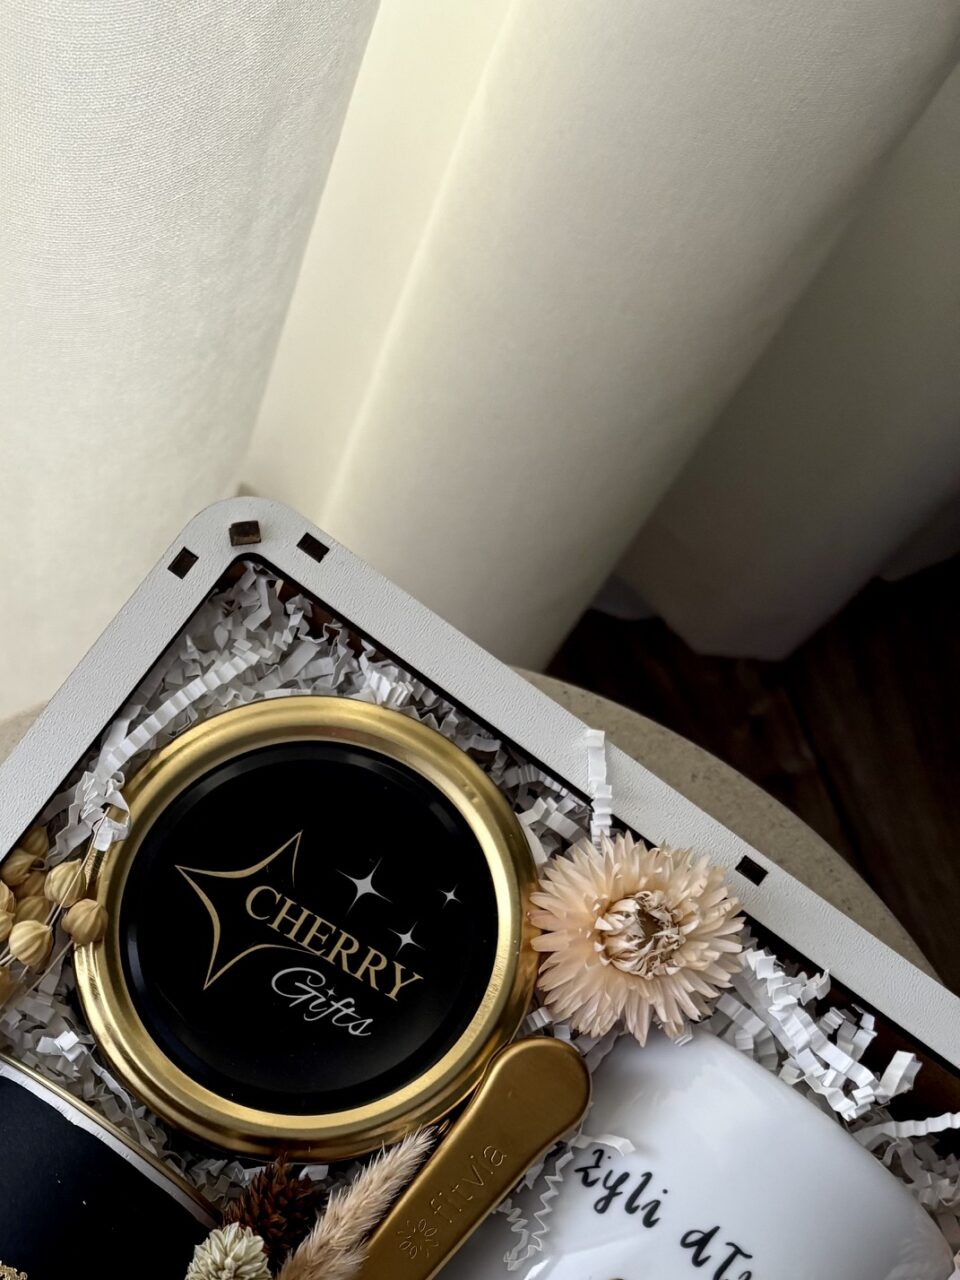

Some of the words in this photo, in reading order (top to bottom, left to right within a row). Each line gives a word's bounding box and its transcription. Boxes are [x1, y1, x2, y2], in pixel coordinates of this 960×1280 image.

[245, 885, 424, 1002] CHERRY
[271, 966, 374, 1037] Gifts
[429, 1145, 508, 1224] fitvia
[574, 1148, 668, 1228] żyli
